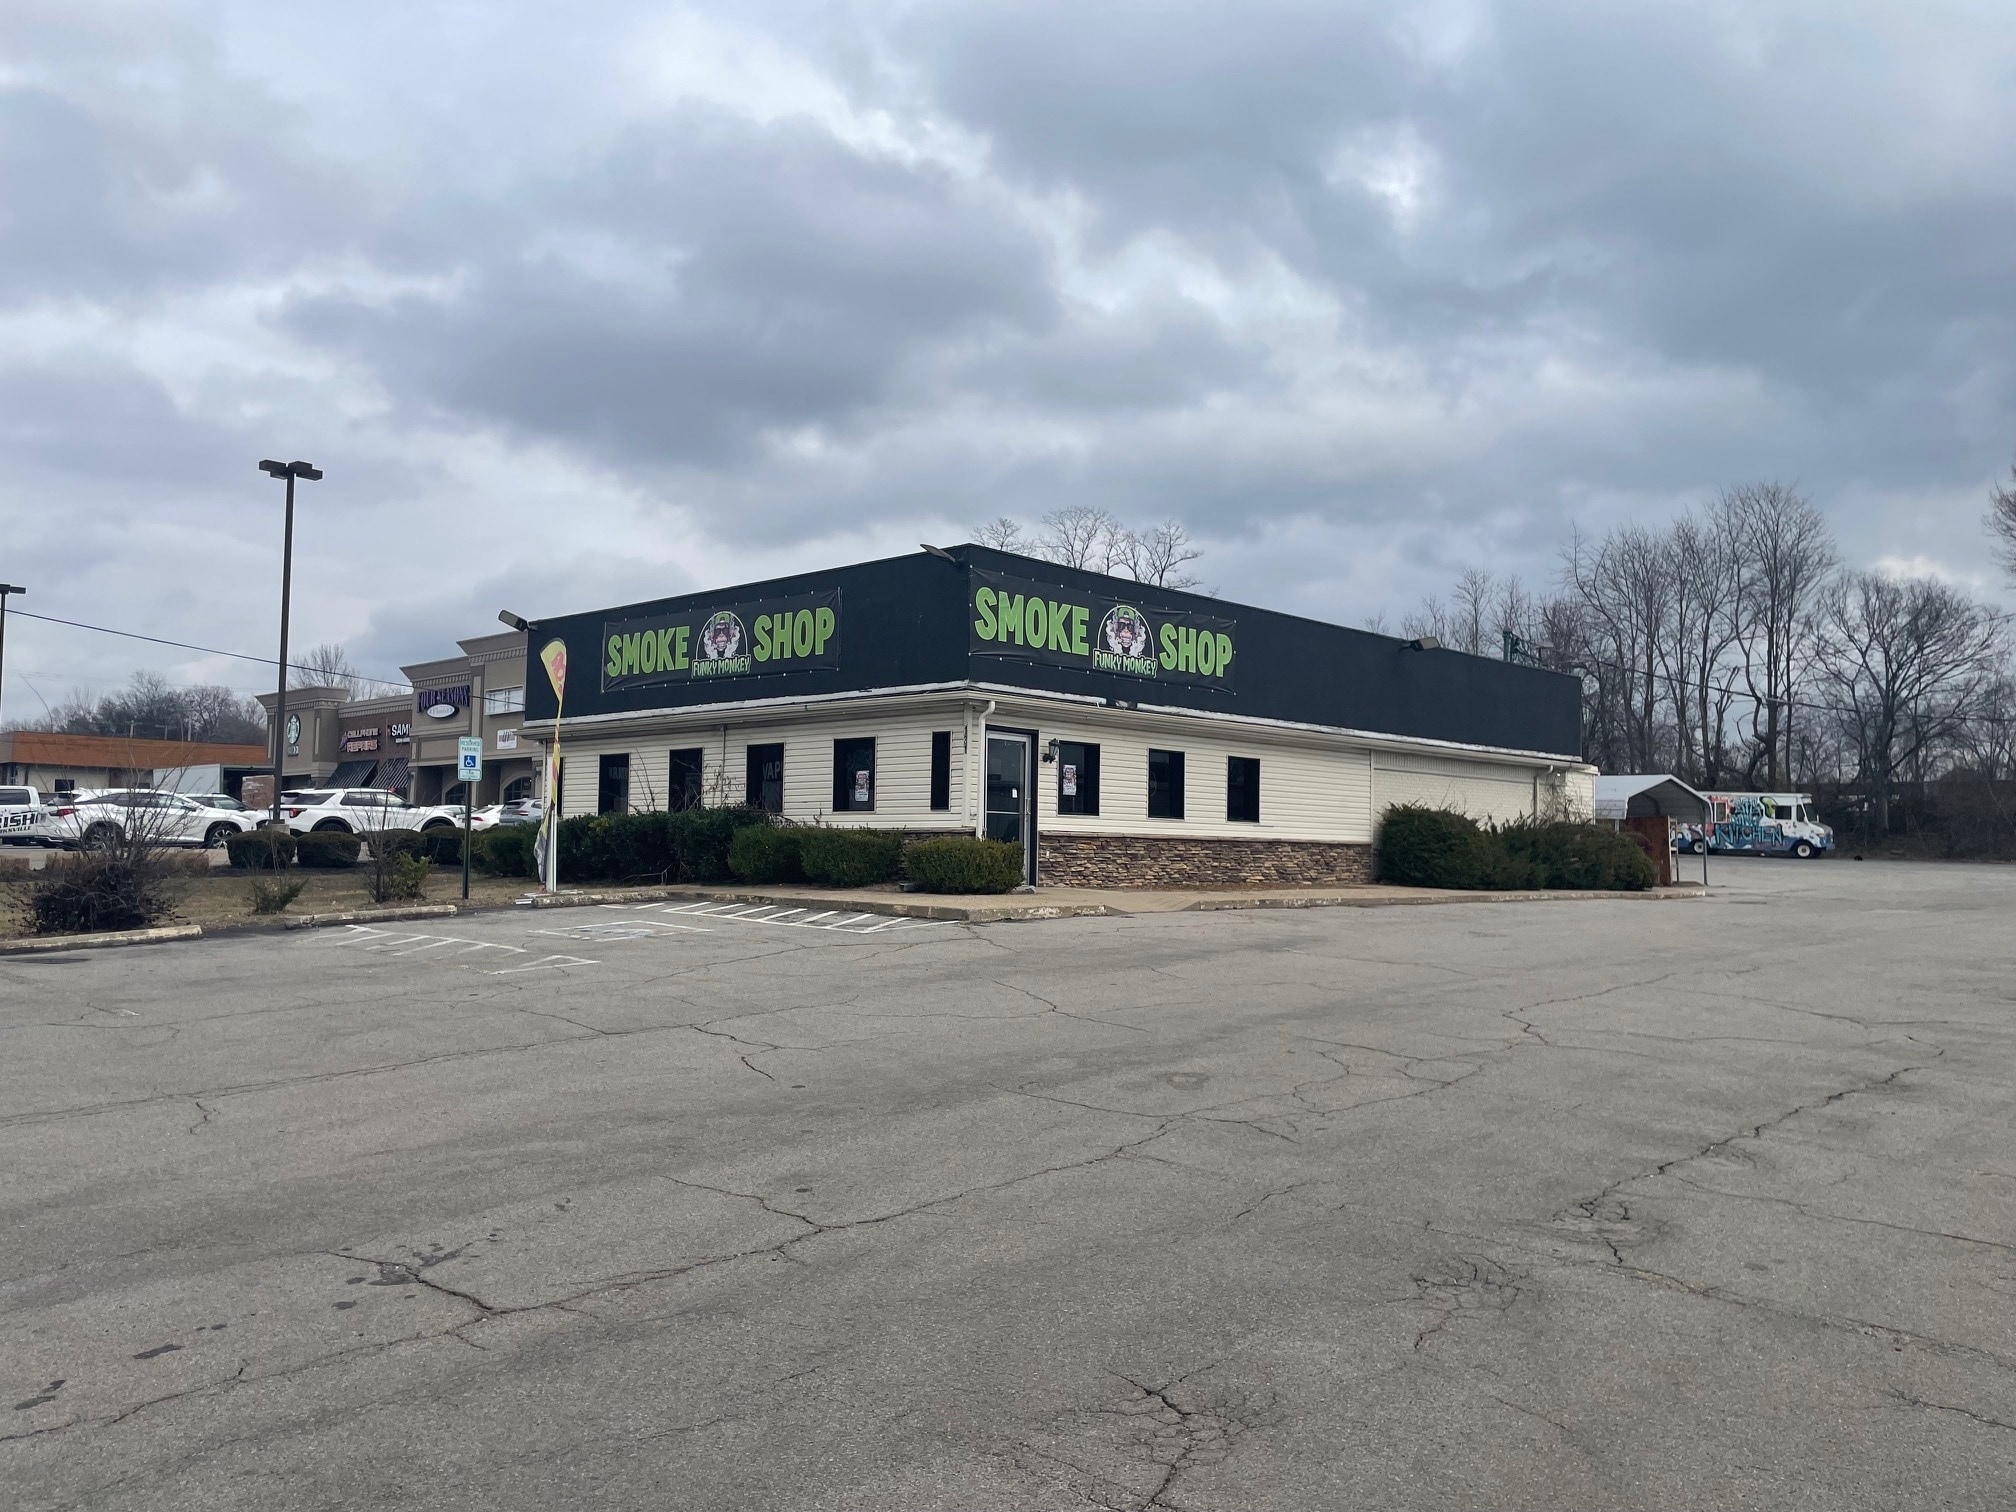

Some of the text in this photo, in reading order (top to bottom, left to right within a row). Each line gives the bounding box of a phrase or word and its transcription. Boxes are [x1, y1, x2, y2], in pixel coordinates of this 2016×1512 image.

[607, 626, 691, 677] SMOKE
[753, 607, 835, 662] SHOP
[974, 586, 1233, 678] SMOKE SHOP
[693, 656, 750, 676] FUNKY MONKEY
[1094, 651, 1156, 676] FUNKY MONKEY
[416, 685, 470, 713] FOUR SEASONS
[1714, 823, 1784, 847] KITCHEN
